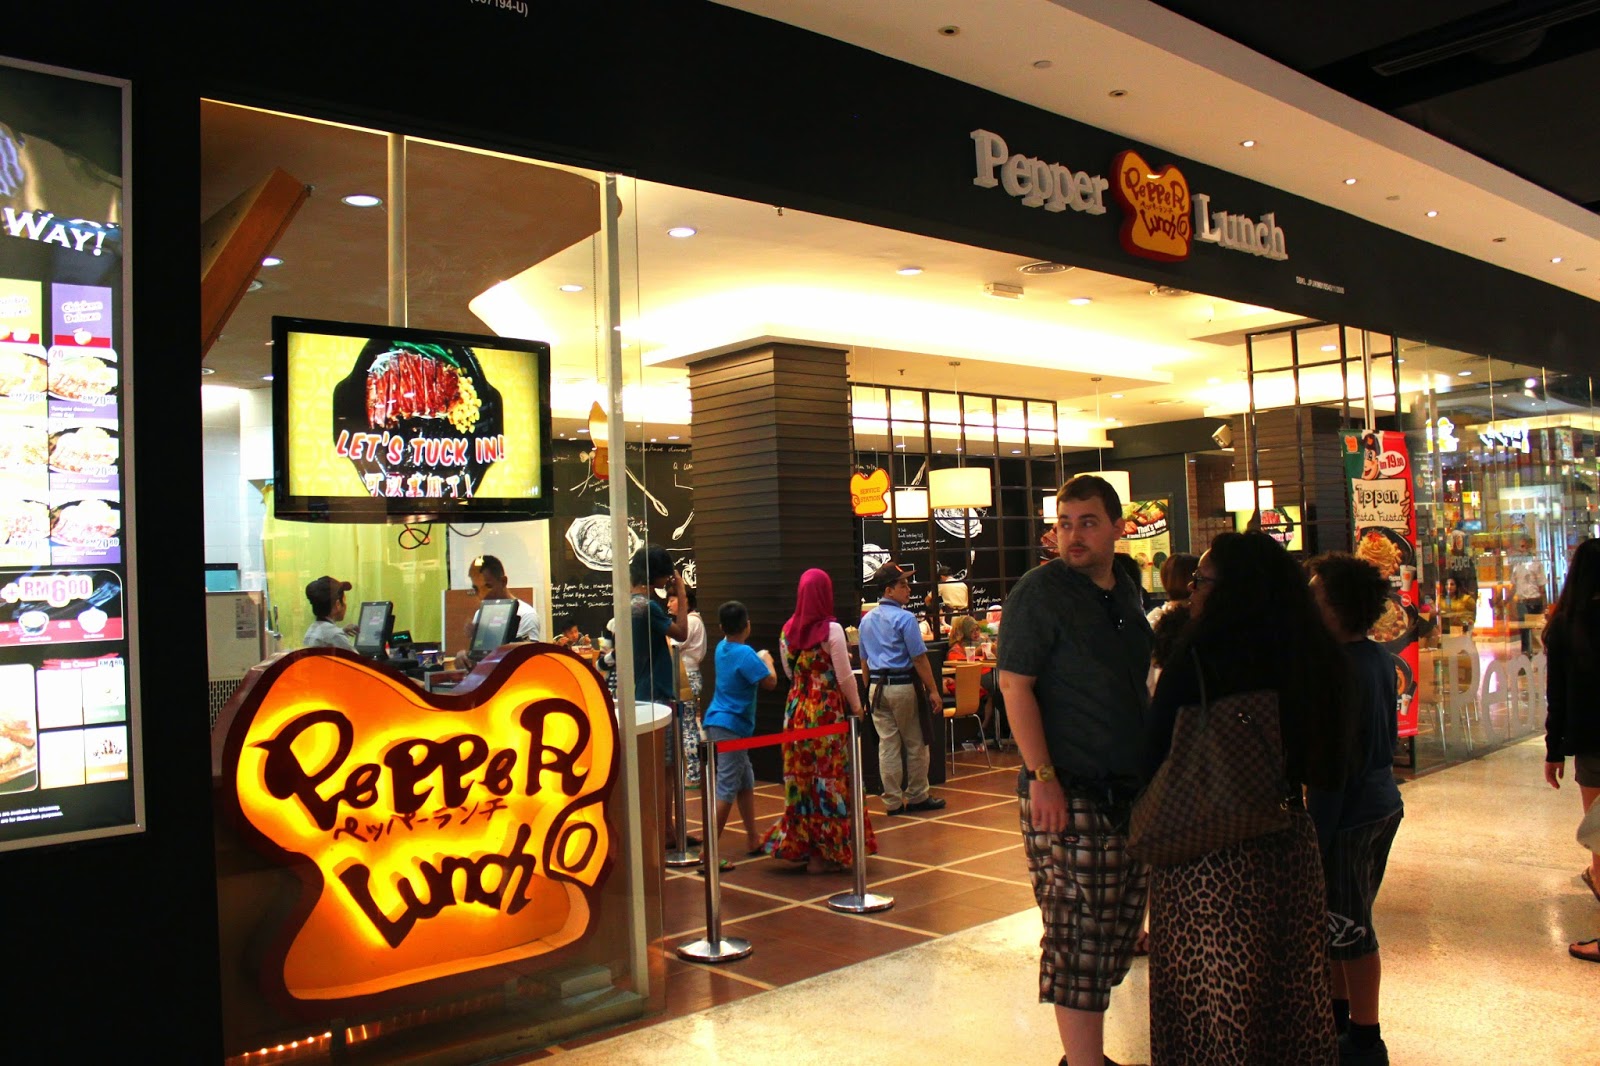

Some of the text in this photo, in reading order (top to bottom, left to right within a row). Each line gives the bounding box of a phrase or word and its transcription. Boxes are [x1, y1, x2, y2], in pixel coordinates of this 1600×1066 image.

[970, 129, 1108, 215] Pepper
[4, 207, 107, 257] WAY!
[1191, 193, 1288, 261] Lunch
[337, 430, 505, 467] LET'S TUCK IN!
[333, 797, 508, 843] ペッパーランチ
[338, 823, 537, 949] Lunch
